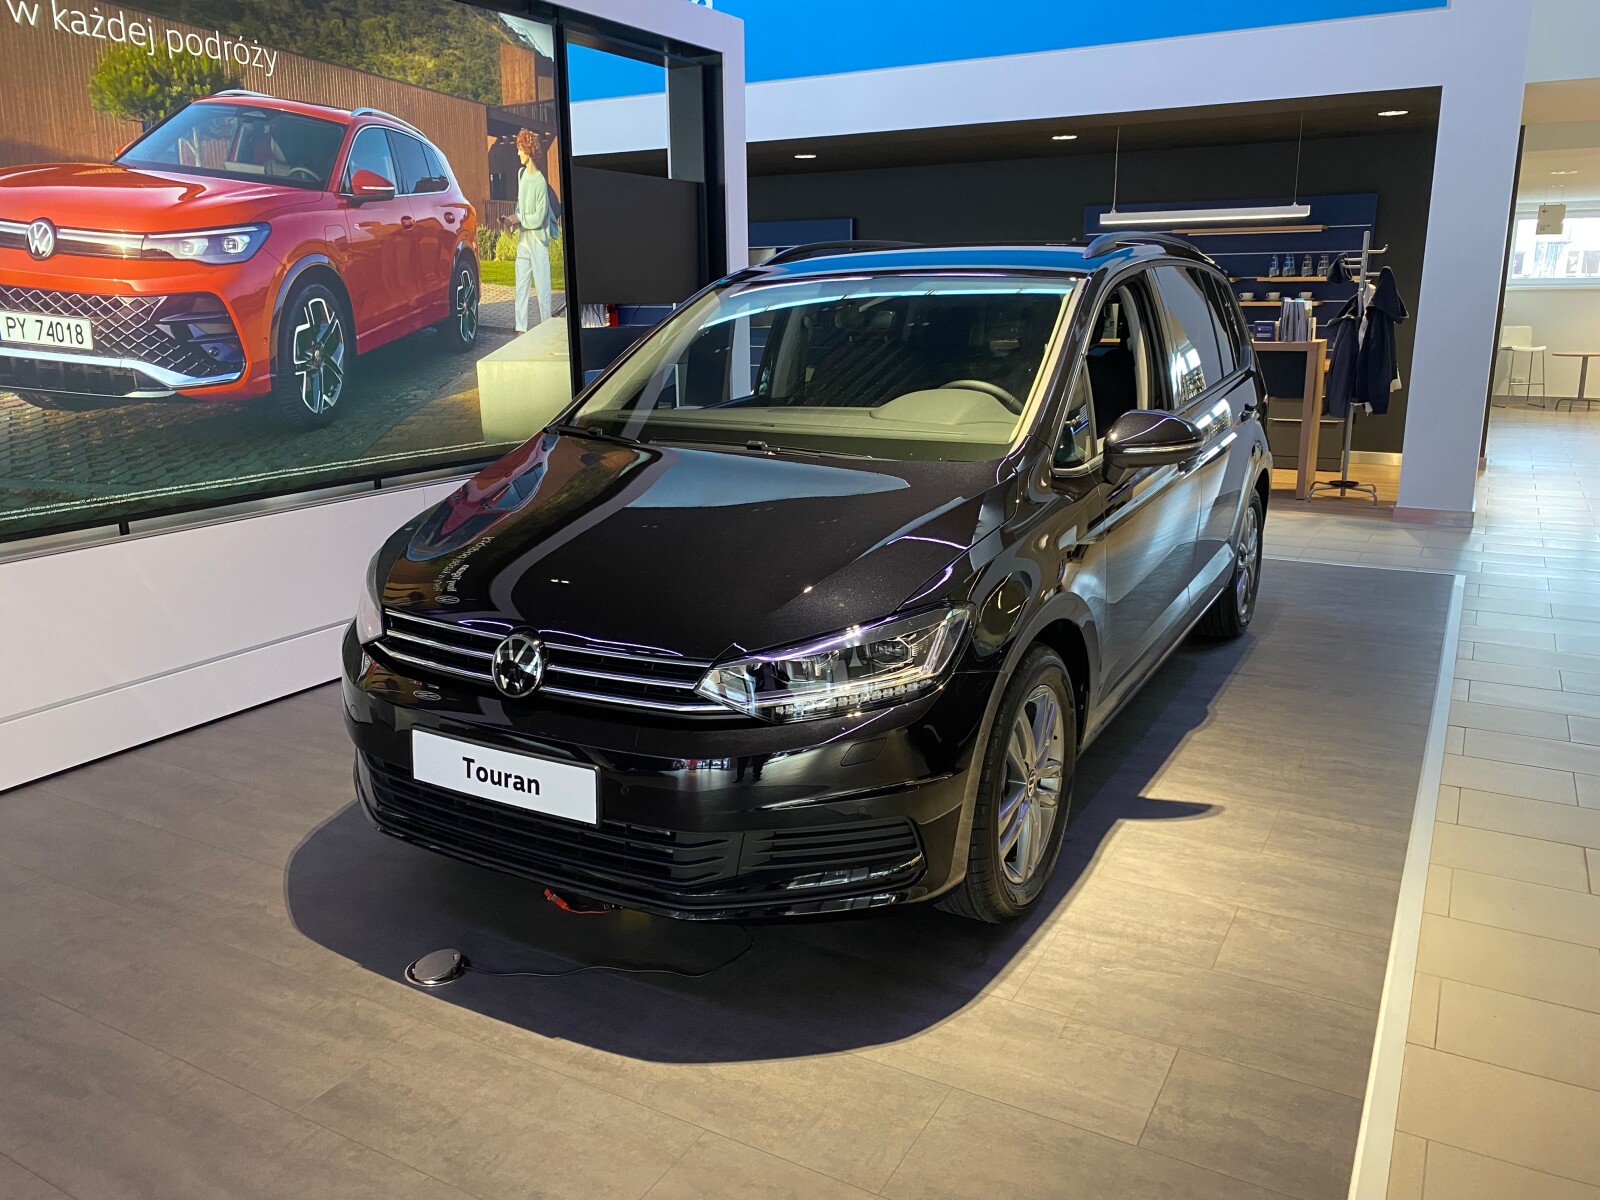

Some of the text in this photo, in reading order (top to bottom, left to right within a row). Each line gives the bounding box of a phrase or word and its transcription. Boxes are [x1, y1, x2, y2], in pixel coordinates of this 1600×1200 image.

[6, 0, 277, 77] w każdej podróży
[5, 316, 84, 345] PY 74018
[462, 756, 541, 796] Touran
